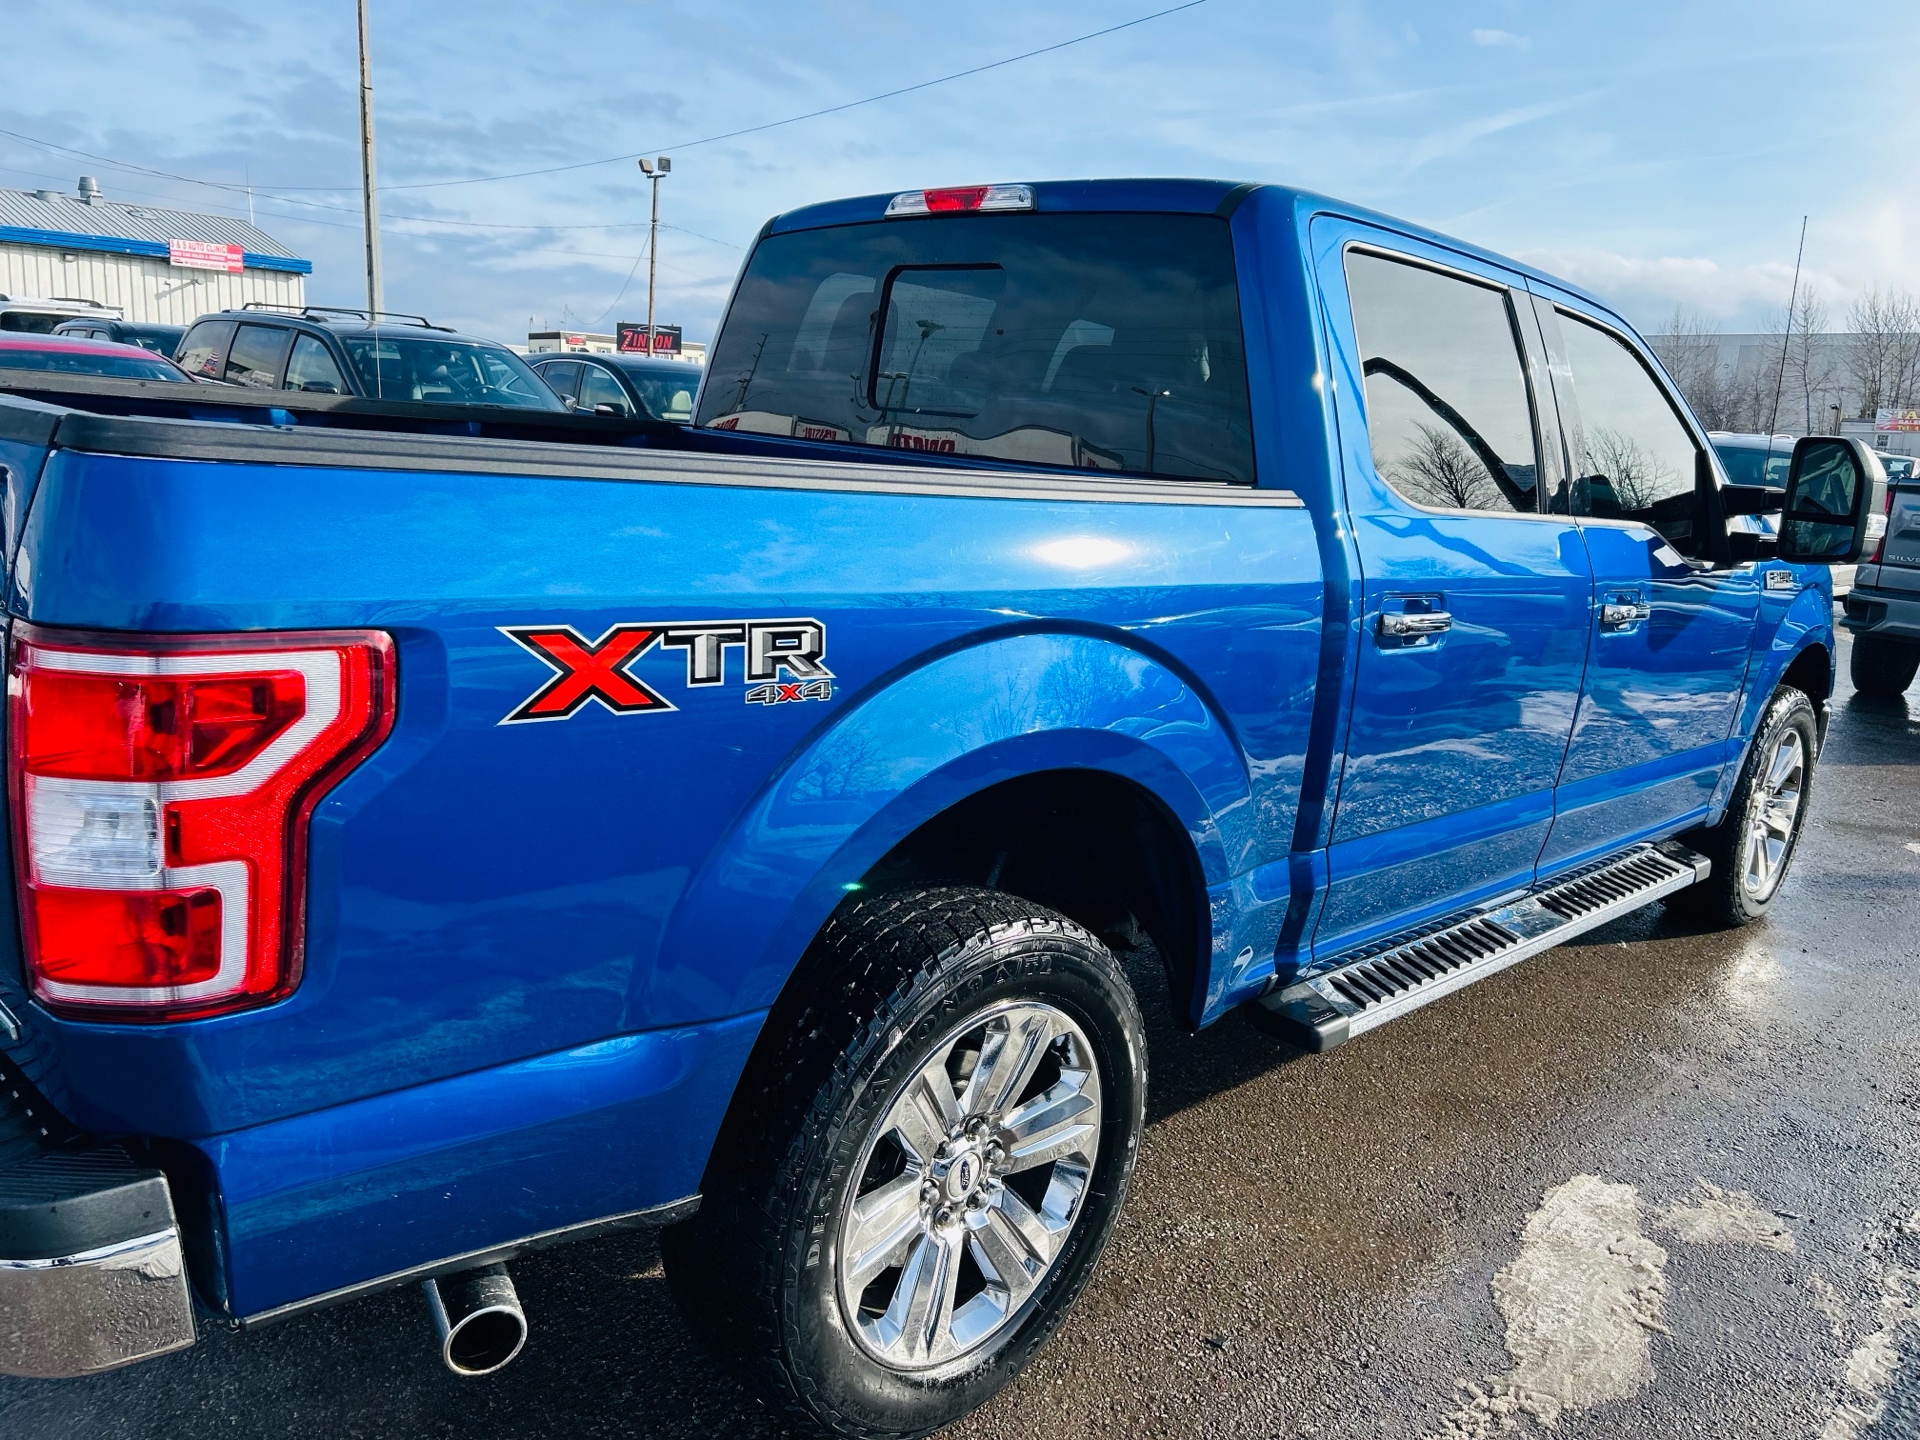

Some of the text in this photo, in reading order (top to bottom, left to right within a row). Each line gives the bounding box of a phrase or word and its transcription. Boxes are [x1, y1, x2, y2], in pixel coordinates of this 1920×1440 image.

[188, 241, 205, 251] AUTO
[206, 243, 226, 254] CLINIC
[620, 330, 674, 352] ZINON
[495, 617, 836, 726] XTR
[804, 987, 961, 1268] DESTINATION
[961, 1163, 971, 1187] Ford
